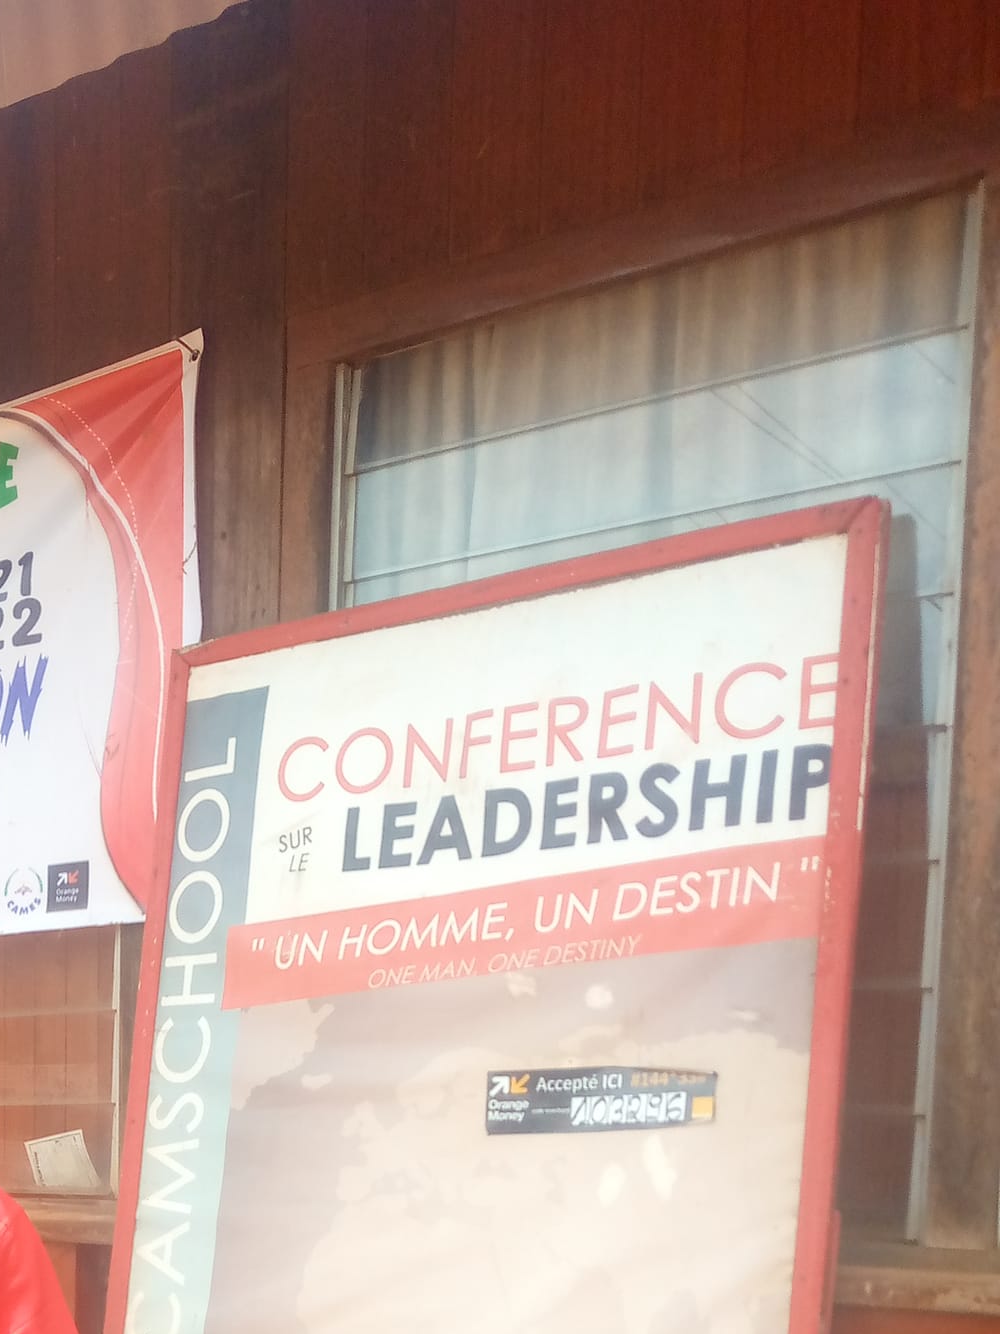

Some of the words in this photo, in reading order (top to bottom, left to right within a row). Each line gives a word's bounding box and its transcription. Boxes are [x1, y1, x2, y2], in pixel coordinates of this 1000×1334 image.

[277, 654, 839, 803] CONFERENCE
[341, 743, 833, 873] LEADERSHIP
[278, 826, 313, 854] SUR
[289, 853, 308, 873] LE
[7, 898, 41, 916] CAMES
[337, 902, 514, 961] HOMME,
[534, 893, 599, 936] UN
[612, 862, 782, 922] DESTIN
[367, 966, 415, 990] ONE
[487, 949, 541, 974] ONE
[543, 934, 643, 969] DESTINY
[535, 1073, 600, 1094] Accepté
[602, 1073, 623, 1089] ICI
[487, 1099, 530, 1113] Orange
[487, 1110, 526, 1123] Money
